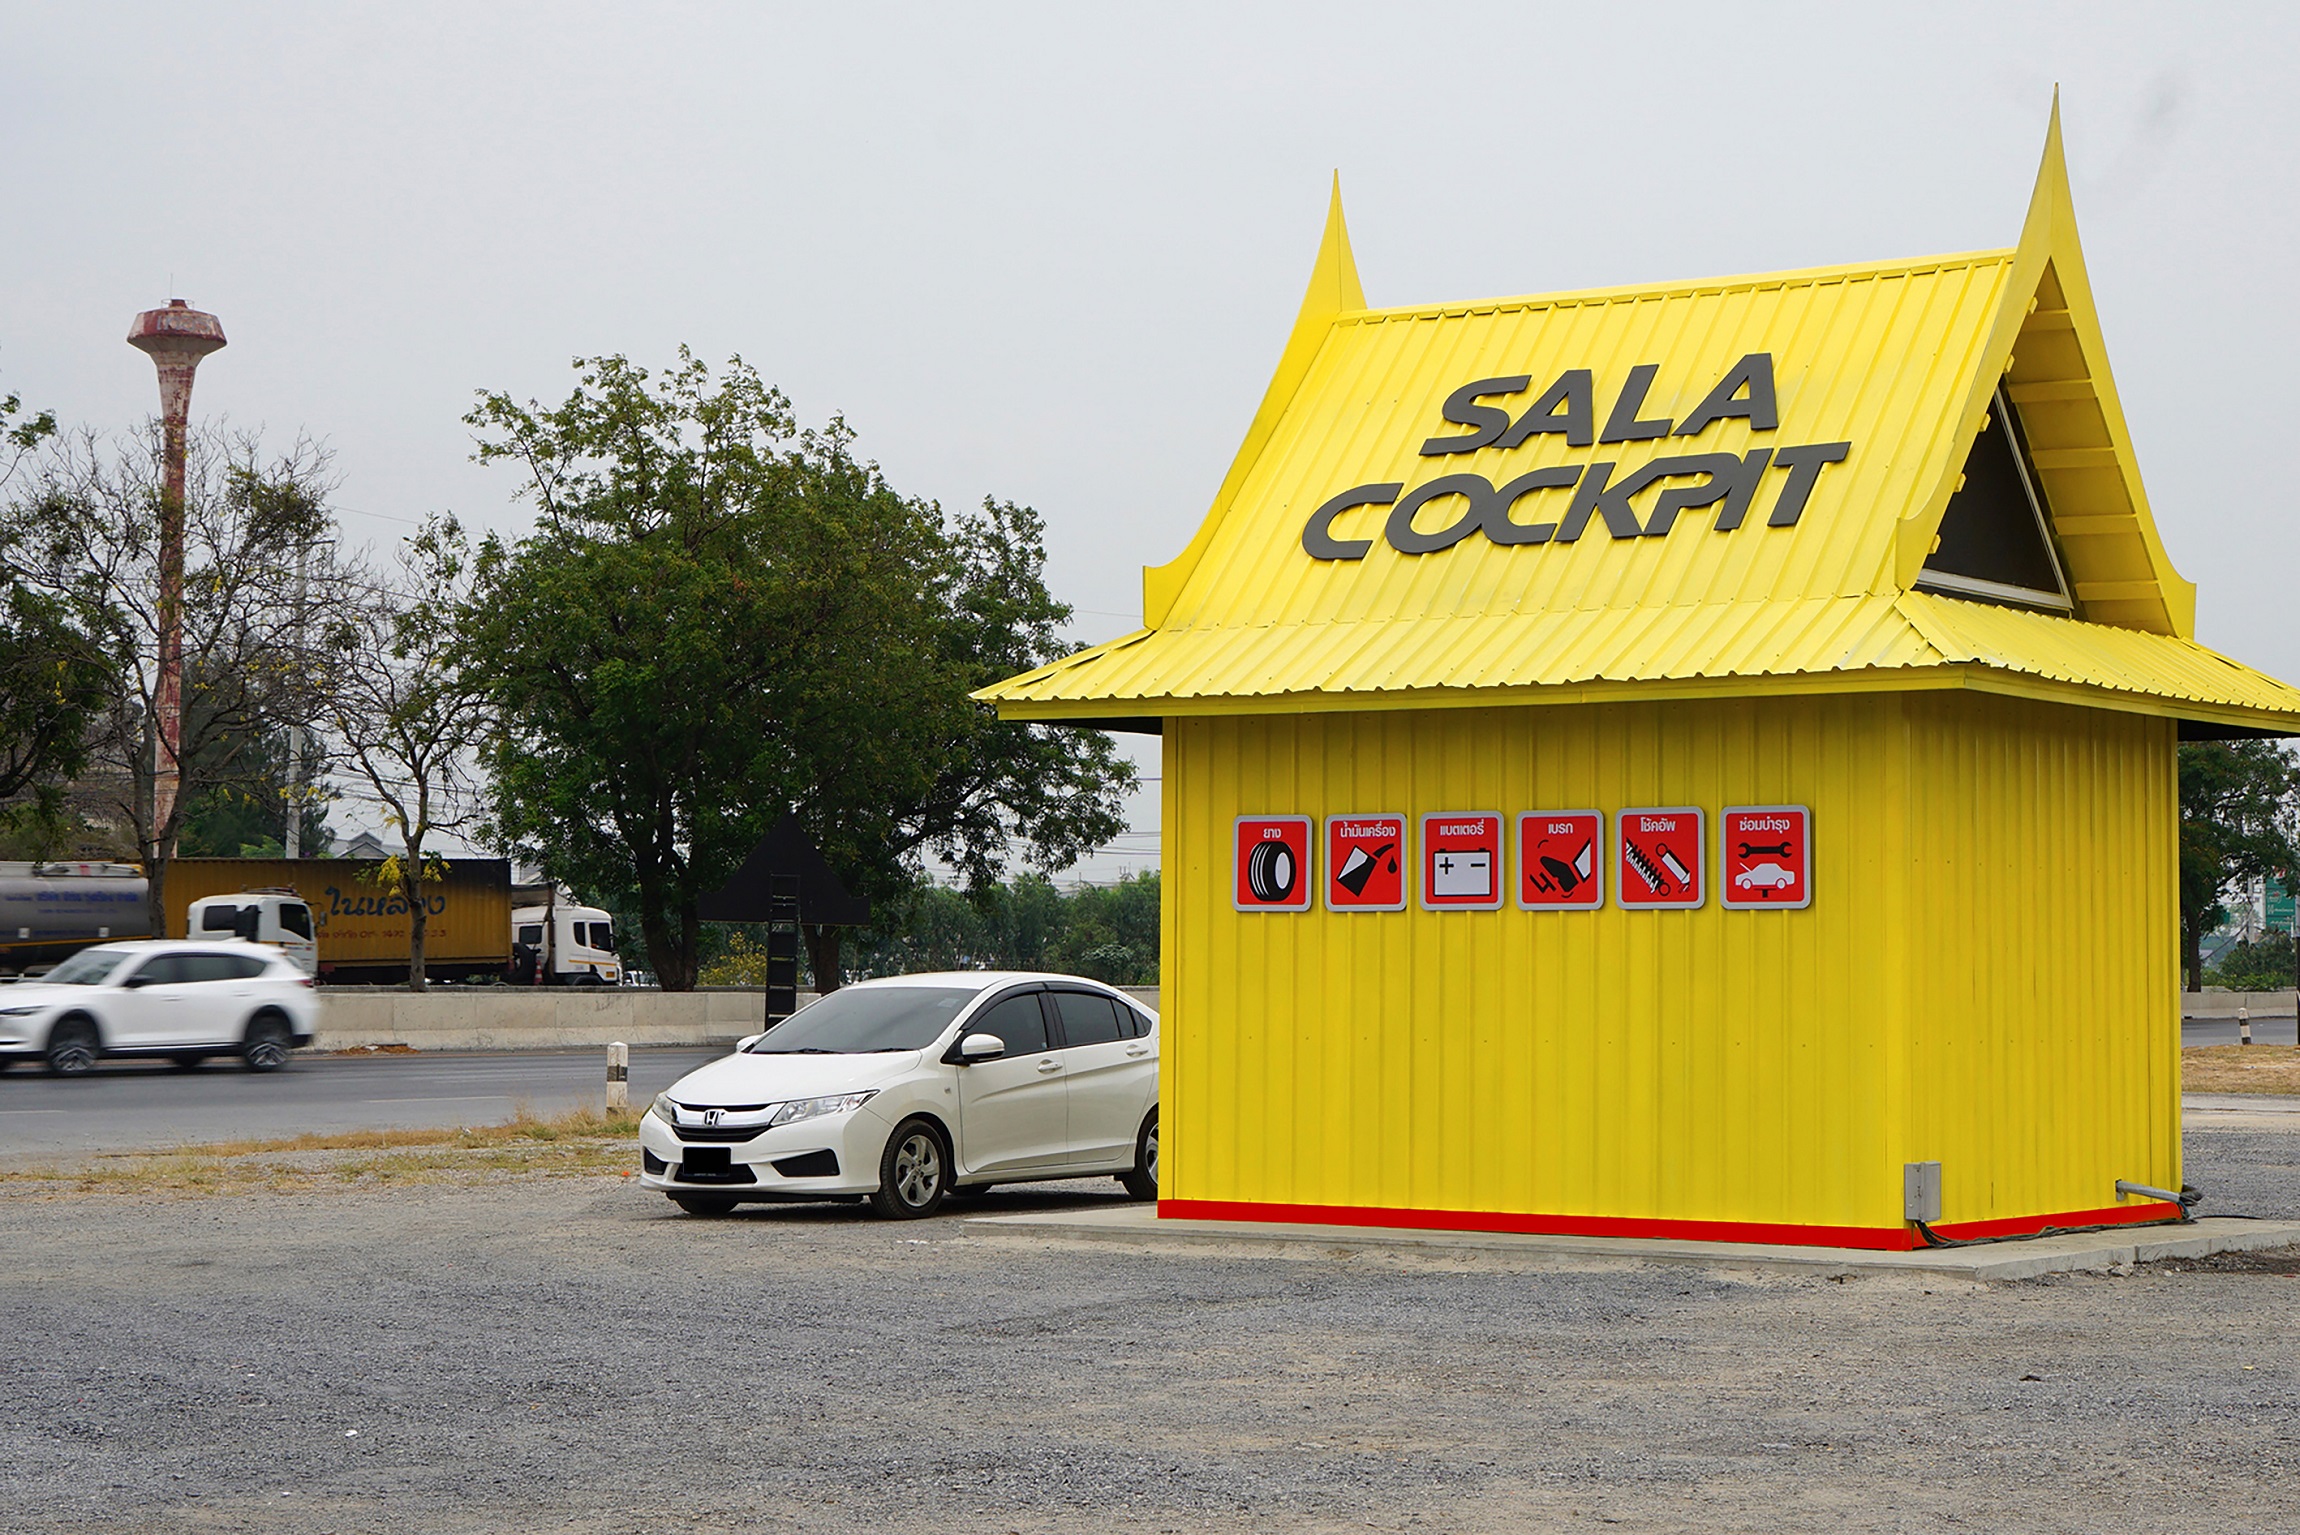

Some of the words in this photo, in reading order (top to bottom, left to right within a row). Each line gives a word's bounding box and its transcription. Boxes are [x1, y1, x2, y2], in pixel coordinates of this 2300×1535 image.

[1419, 352, 1778, 456] SALA
[1301, 441, 1852, 560] COCKPIT
[1340, 821, 1396, 838] น้ำมันเครื่อง
[1440, 819, 1485, 836] แบตเตอรี่
[1548, 822, 1573, 834] เบรก
[1640, 816, 1676, 832] โช้คอัพ
[1739, 816, 1790, 834] ซ่อมบำรุง
[1263, 827, 1281, 839] ยาง
[325, 885, 446, 916] ในหลง
